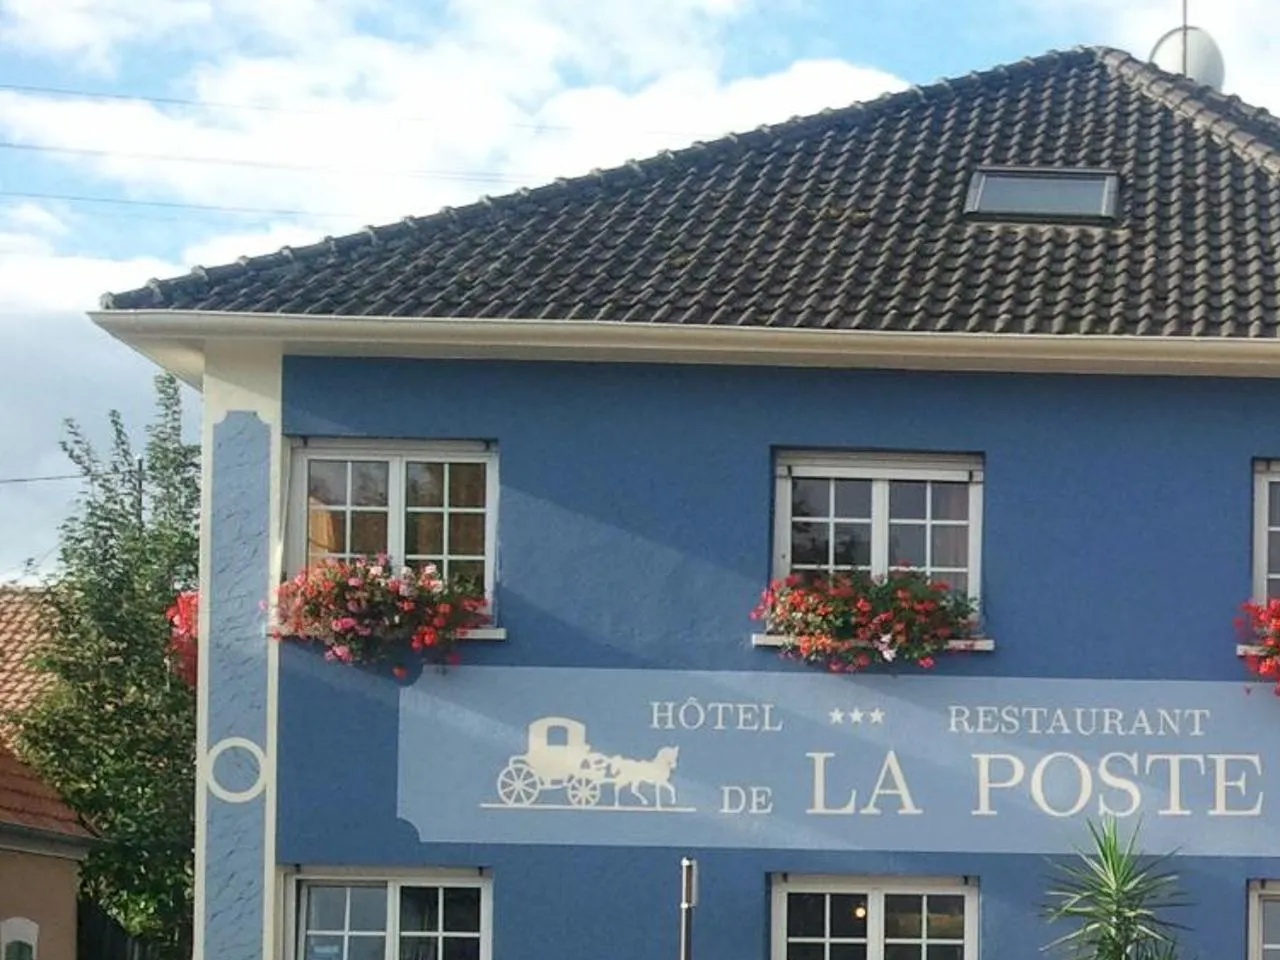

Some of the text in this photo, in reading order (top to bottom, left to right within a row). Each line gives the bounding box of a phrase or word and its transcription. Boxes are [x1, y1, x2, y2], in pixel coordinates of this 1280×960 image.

[649, 697, 1210, 737] HÔTEL RESTAURANT
[719, 750, 1264, 818] DE LA POSTE
